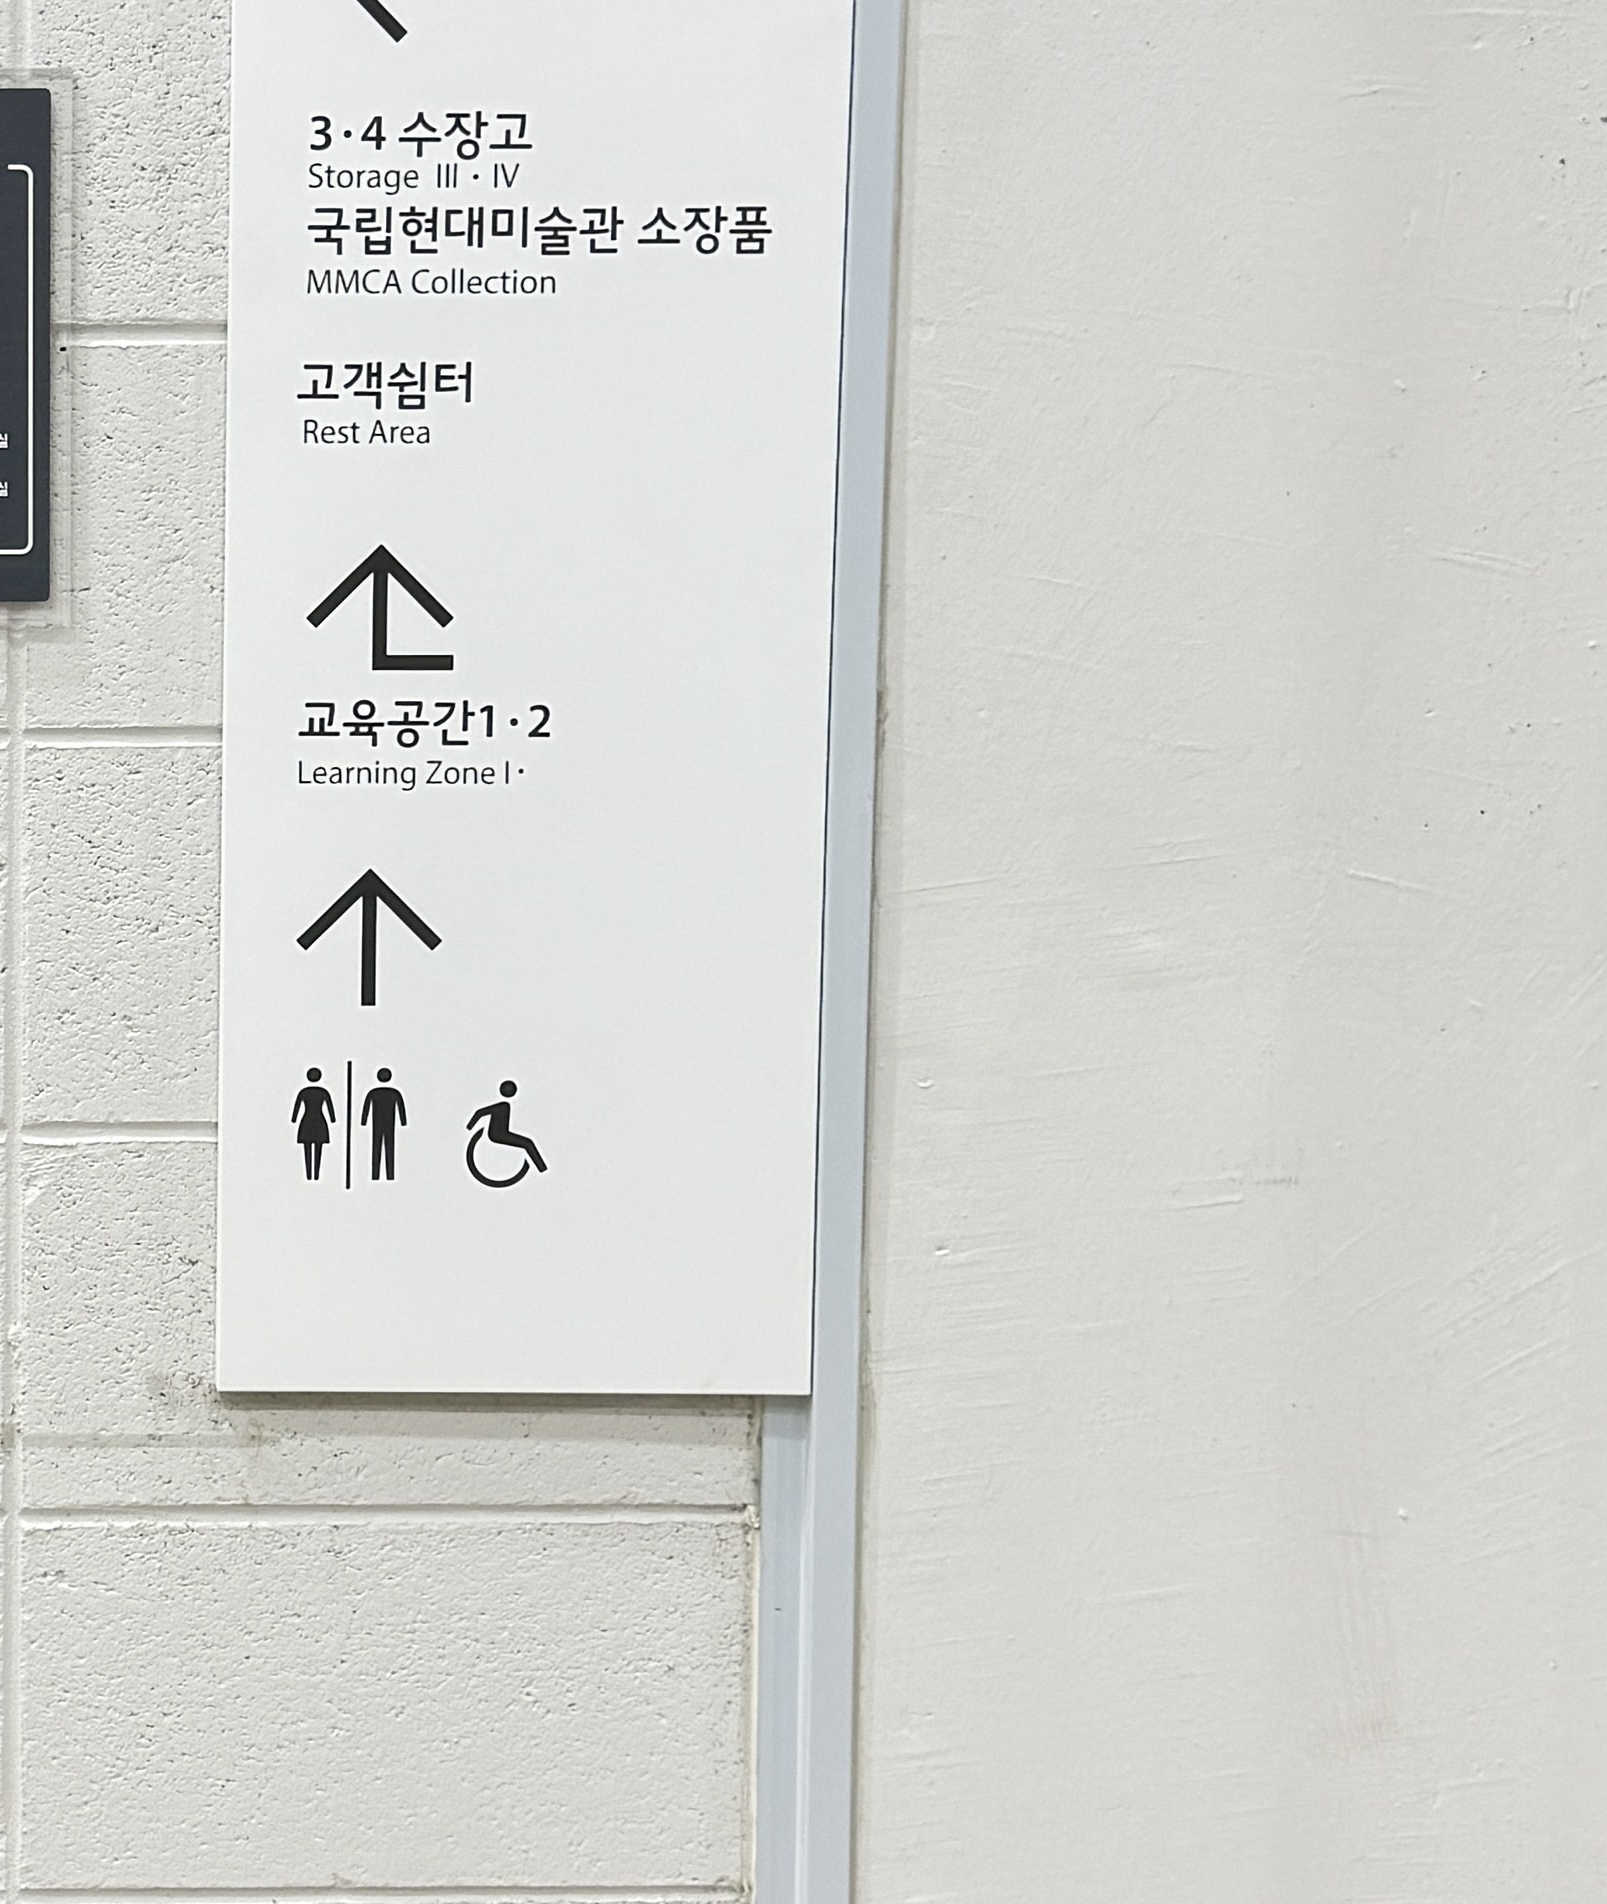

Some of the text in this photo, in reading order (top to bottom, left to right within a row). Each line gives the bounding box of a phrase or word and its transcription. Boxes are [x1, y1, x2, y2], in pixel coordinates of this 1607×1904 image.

[309, 110, 533, 160] 3·4 수장고
[308, 163, 419, 195] Storage
[307, 205, 773, 256] 국립현대미술관 소장품
[307, 267, 556, 295] MMCA Collection
[296, 361, 472, 410] 고객쉼터
[303, 419, 430, 444] Rest Area
[298, 760, 416, 791] Learning
[425, 760, 496, 785] Zone
